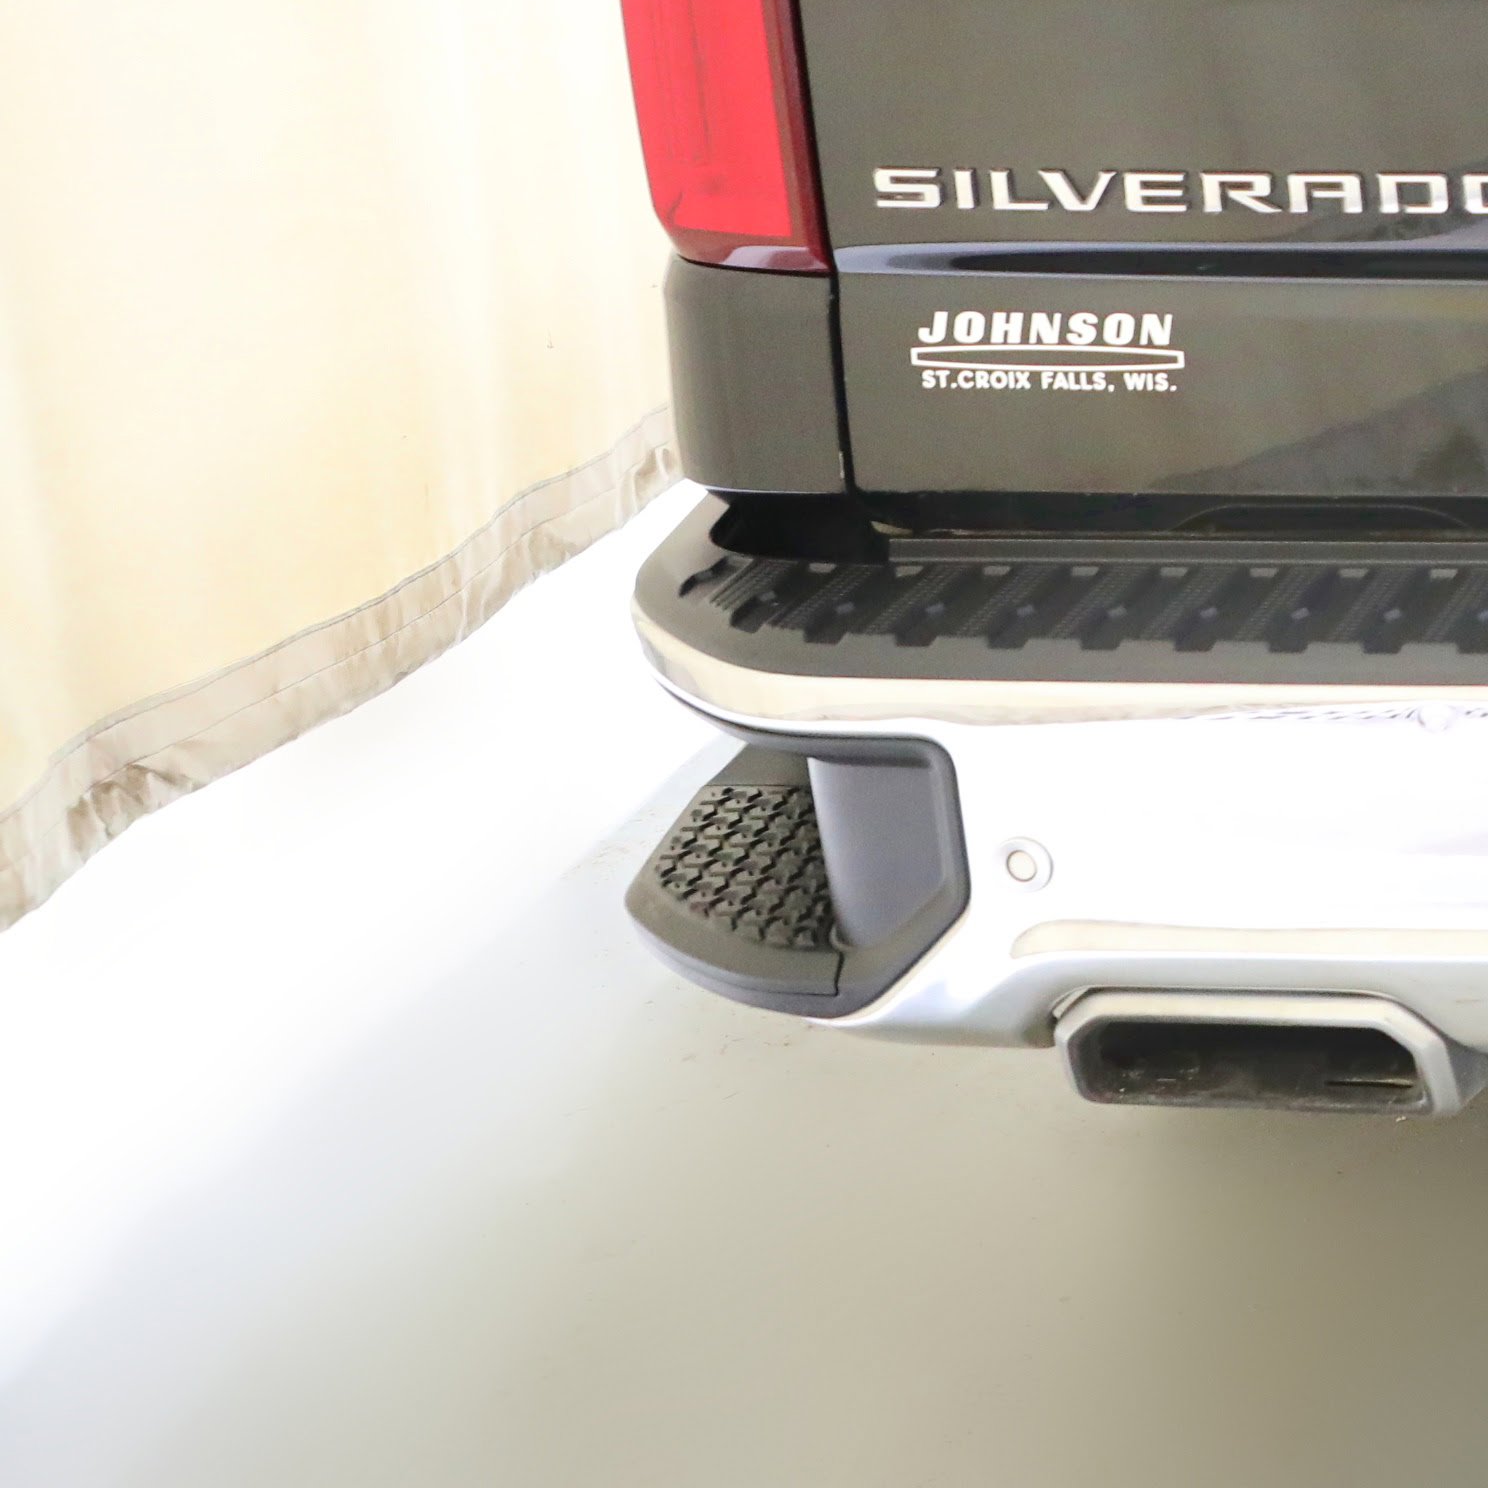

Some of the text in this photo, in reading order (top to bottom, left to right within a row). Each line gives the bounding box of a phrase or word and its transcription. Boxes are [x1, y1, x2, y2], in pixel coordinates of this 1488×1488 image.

[917, 311, 1175, 346] JOHNSON
[1040, 371, 1115, 393] FALLS,
[1123, 372, 1177, 391] WIS.
